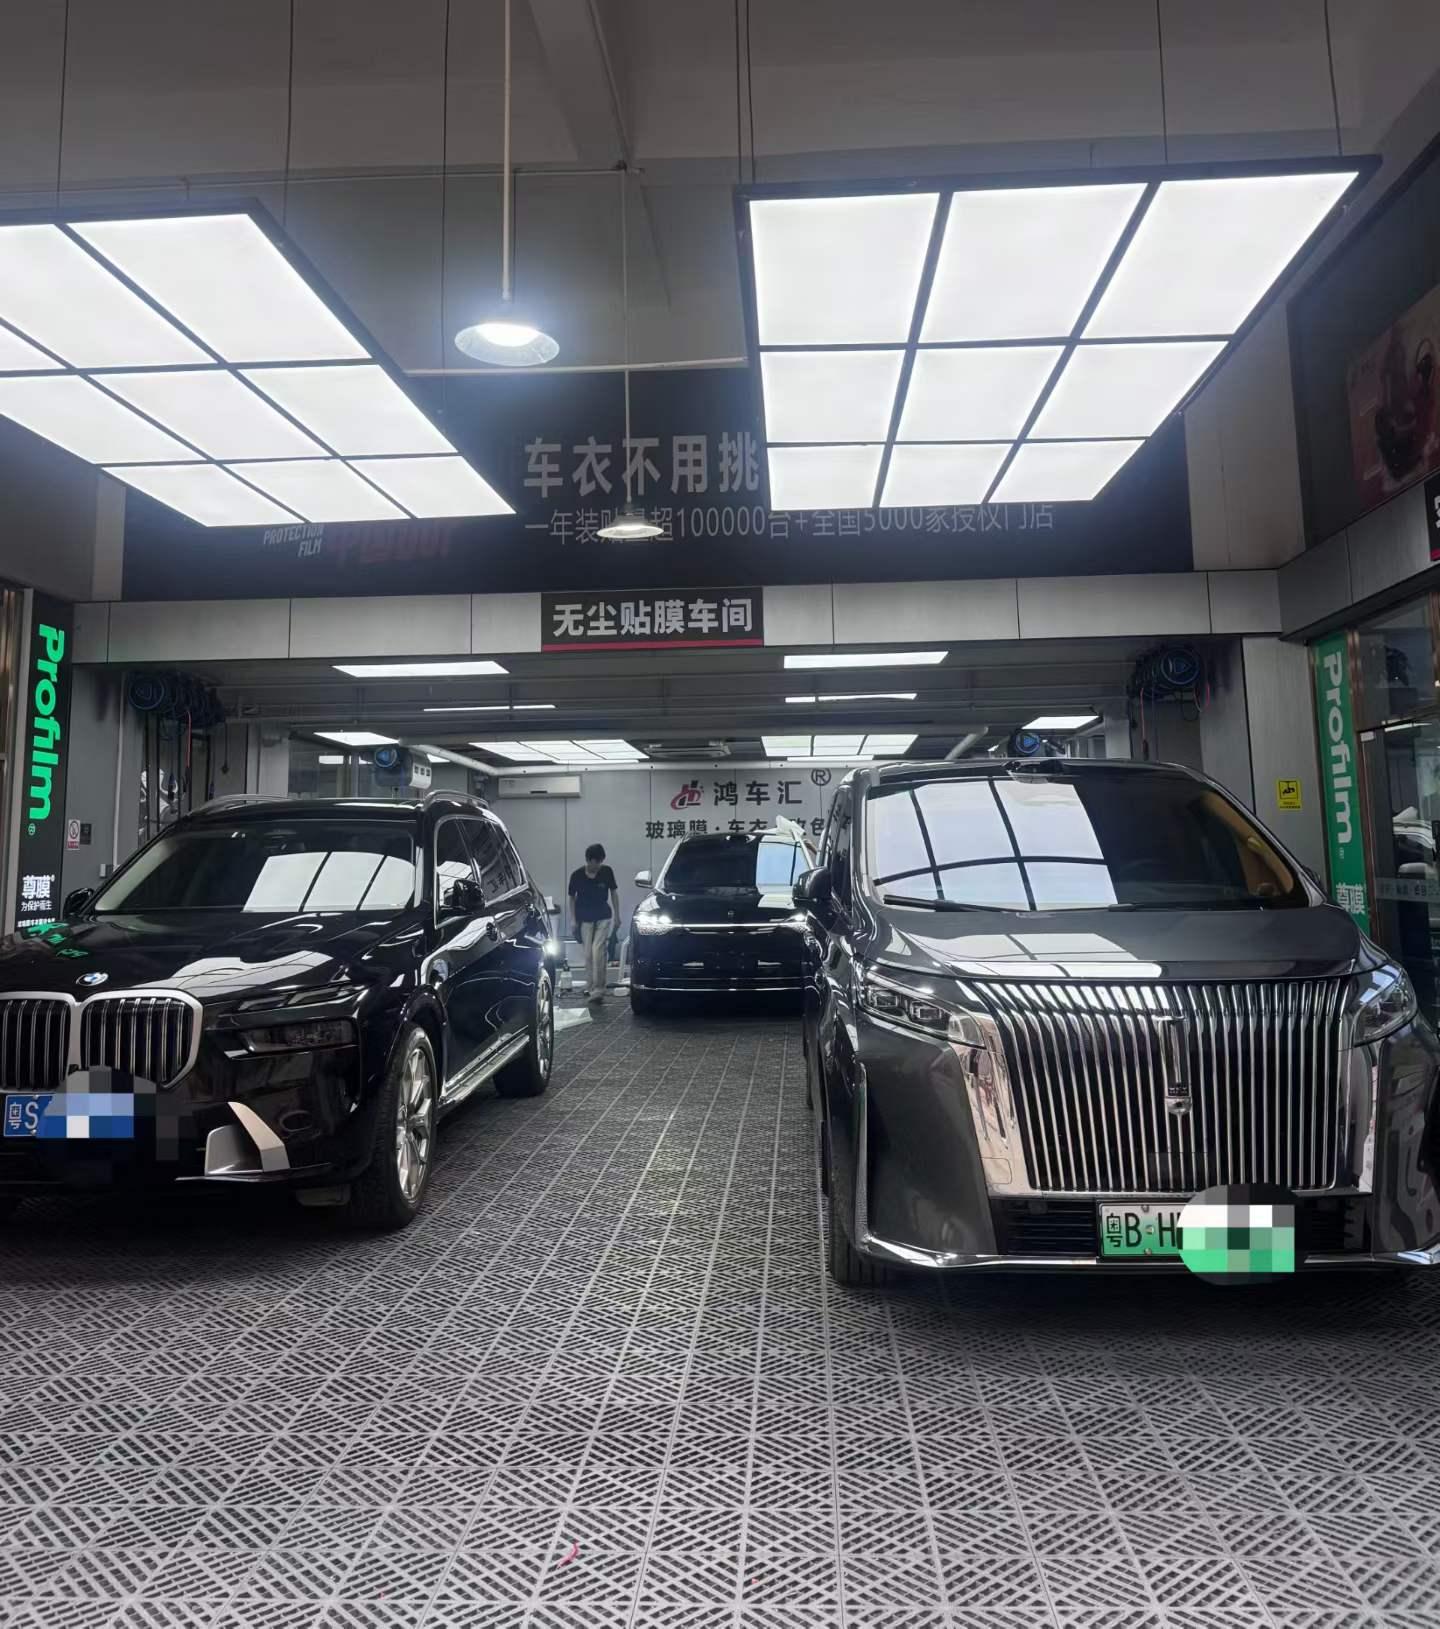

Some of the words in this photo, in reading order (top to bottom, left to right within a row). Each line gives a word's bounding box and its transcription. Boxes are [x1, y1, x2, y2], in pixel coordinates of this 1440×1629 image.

[523, 431, 760, 498] 车衣不用挑
[298, 539, 322, 559] FILM
[553, 599, 753, 637] 无尘贴膜车间
[713, 780, 802, 806] 鸿车汇
[22, 875, 51, 899] 尊膜
